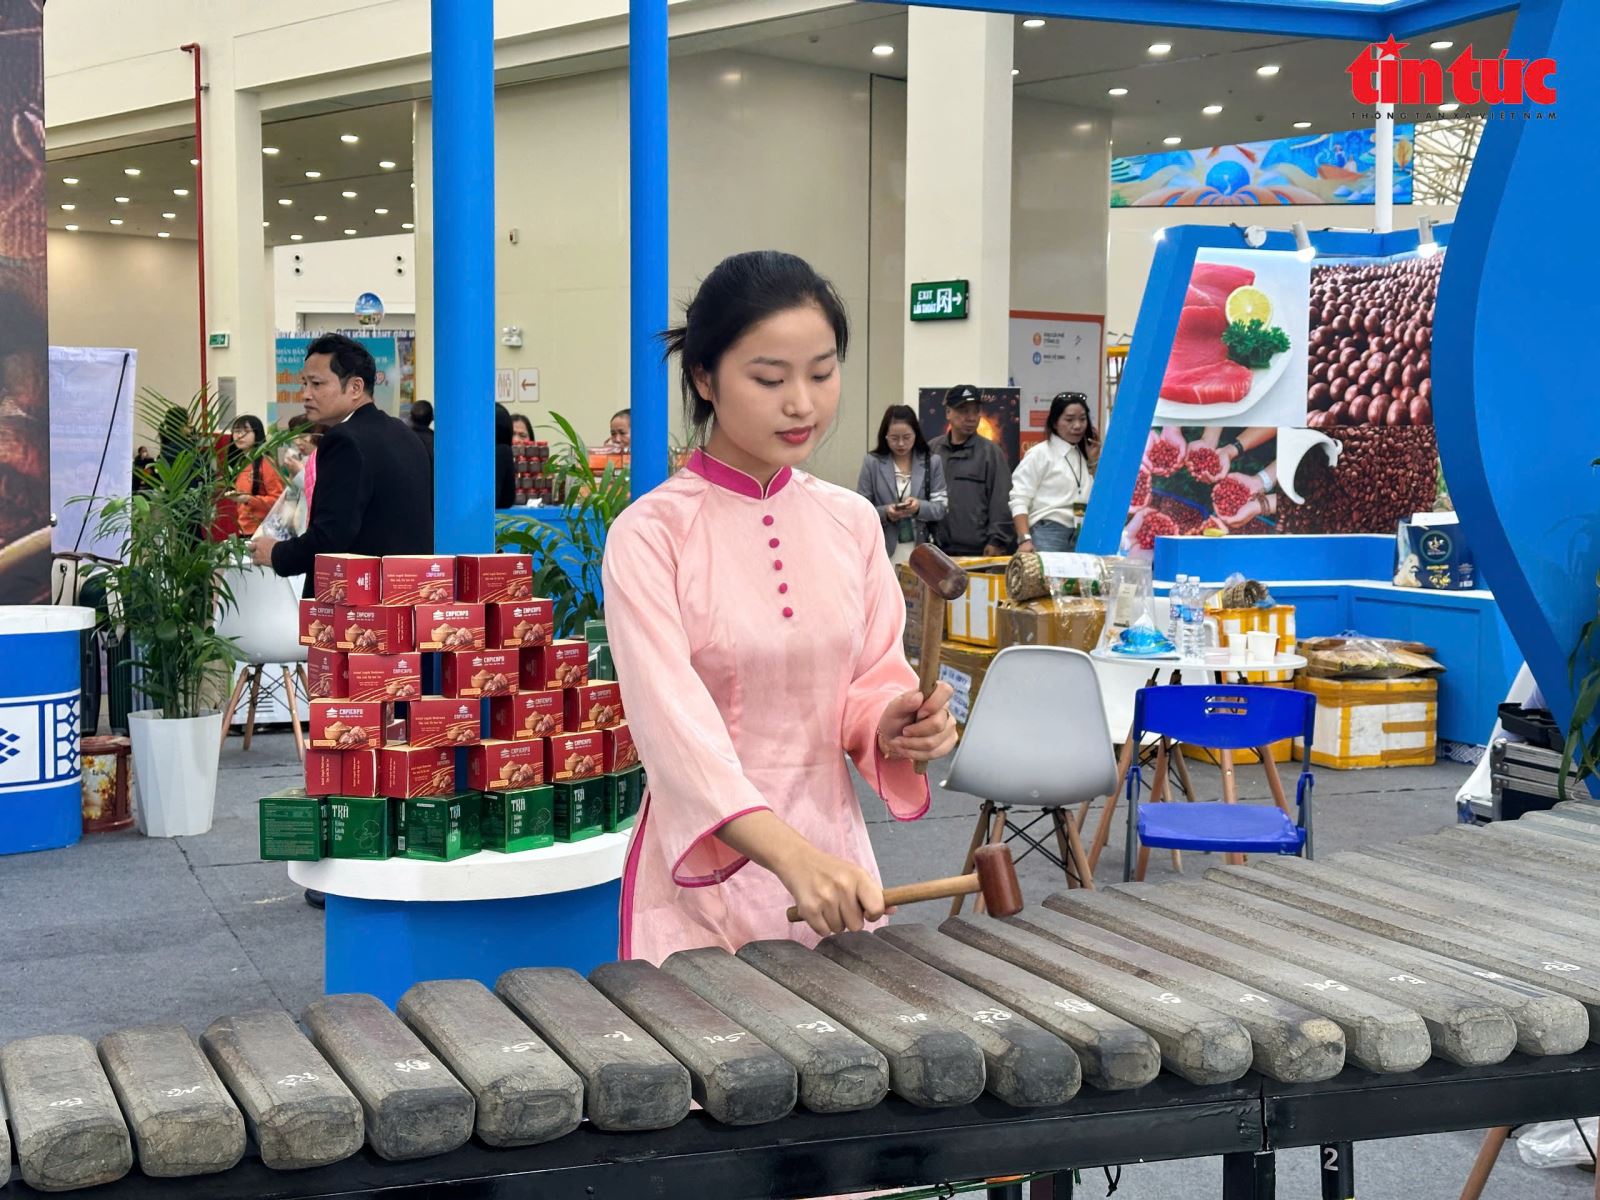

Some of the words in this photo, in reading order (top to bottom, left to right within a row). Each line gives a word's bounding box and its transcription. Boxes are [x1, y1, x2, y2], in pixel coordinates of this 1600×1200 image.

[918, 290, 933, 301] EXIT
[332, 803, 349, 819] TRÀ
[511, 796, 526, 812] TRÀ
[702, 1032, 746, 1044] Sol
[1323, 1147, 1339, 1171] 2
